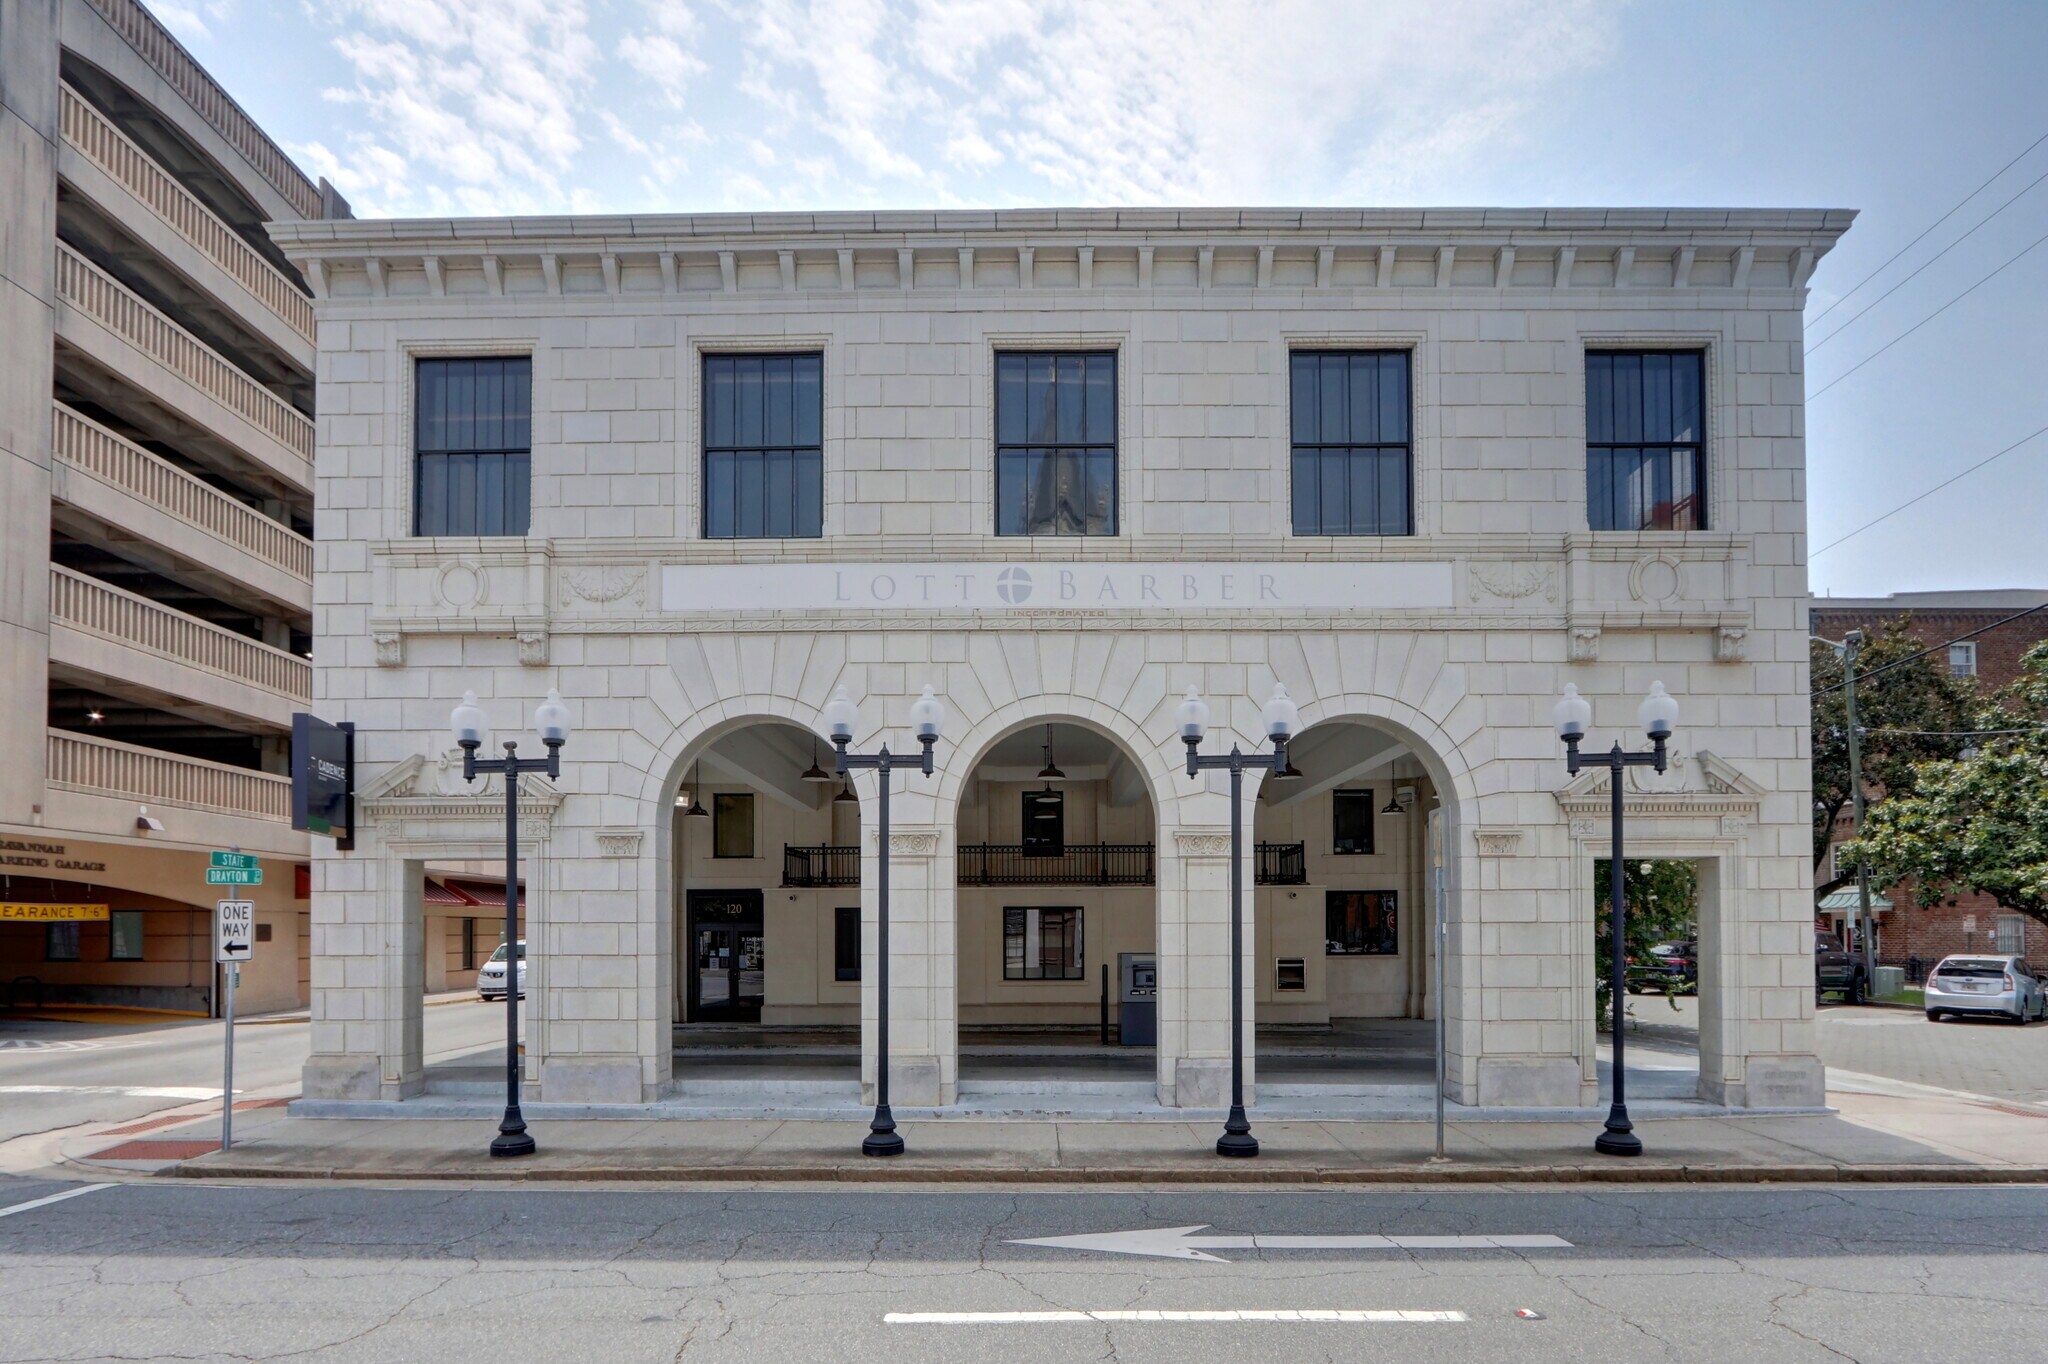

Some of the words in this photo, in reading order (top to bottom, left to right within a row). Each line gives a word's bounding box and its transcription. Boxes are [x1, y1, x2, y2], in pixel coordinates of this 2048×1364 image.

[835, 571, 975, 601] LOTT
[1058, 570, 1281, 600] BARBER
[318, 759, 346, 779] CADENCE
[55, 860, 106, 872] GARAGE
[222, 854, 245, 867] STATE
[210, 870, 249, 883] DRAYTON
[3, 906, 74, 918] EARANCE
[223, 906, 249, 920] ONE
[727, 904, 742, 914] 120
[223, 923, 249, 937] WAY
